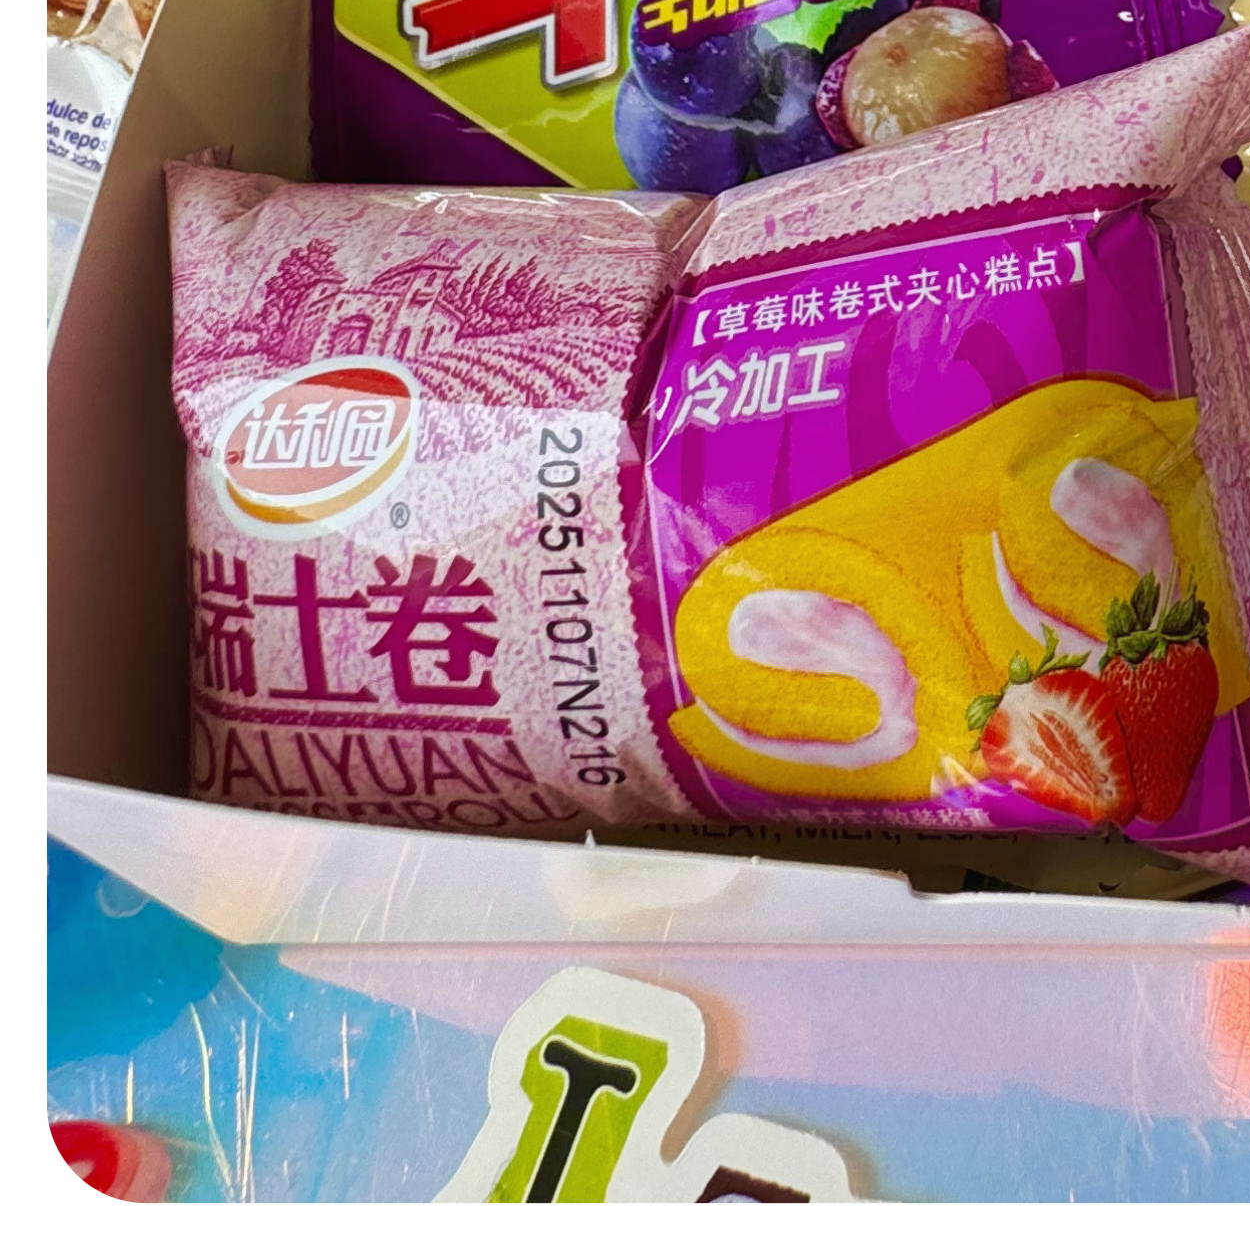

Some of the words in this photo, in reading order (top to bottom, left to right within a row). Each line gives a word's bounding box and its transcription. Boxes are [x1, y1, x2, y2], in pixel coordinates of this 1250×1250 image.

[47, 98, 89, 125] dulce
[92, 111, 112, 131] de
[676, 340, 847, 428] 冷加工
[243, 399, 397, 472] 达利园
[537, 426, 628, 788] 20251107N216
